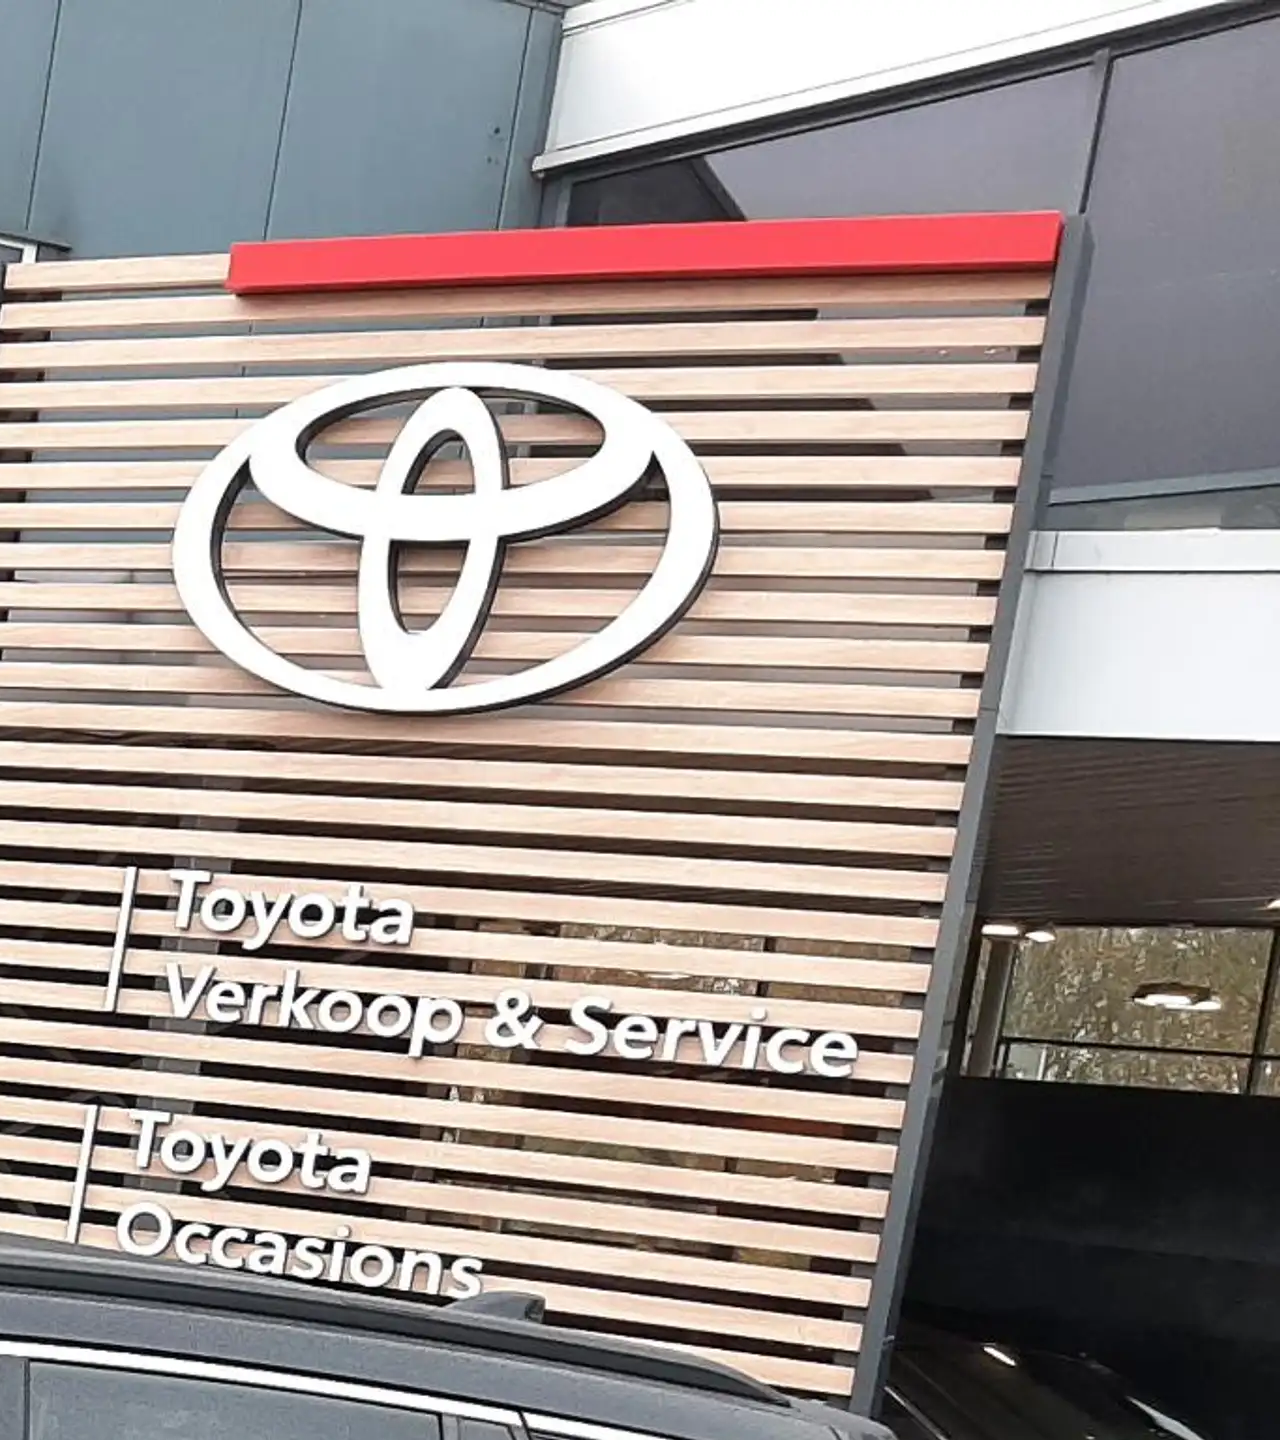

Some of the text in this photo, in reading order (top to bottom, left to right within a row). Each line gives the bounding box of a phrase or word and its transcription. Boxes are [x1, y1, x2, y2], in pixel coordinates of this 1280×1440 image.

[170, 869, 414, 950] Toyota
[166, 963, 859, 1078] Verkoop & Service
[130, 1108, 372, 1194] Toyota
[115, 1201, 484, 1299] Occasions
